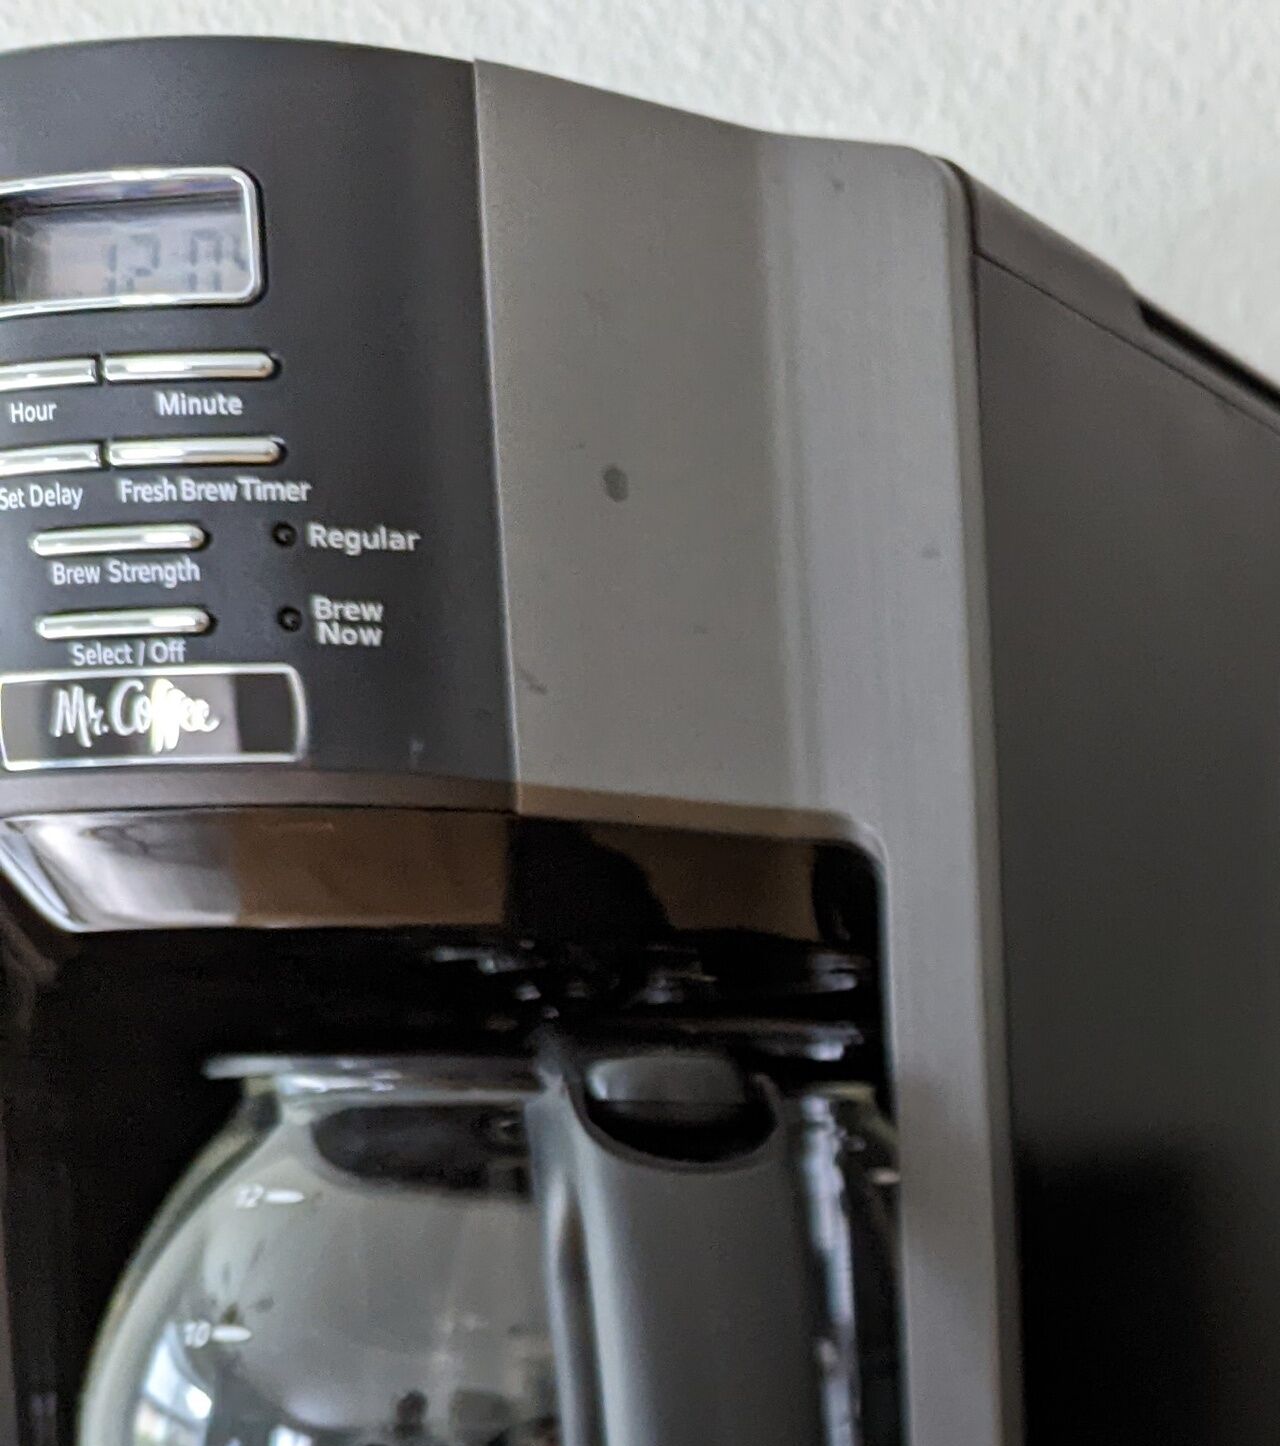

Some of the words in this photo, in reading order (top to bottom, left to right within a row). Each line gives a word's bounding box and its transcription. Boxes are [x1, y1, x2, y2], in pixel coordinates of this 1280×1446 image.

[10, 402, 58, 423] Hour
[157, 391, 244, 416] Minute
[0, 486, 26, 511] Set
[29, 481, 84, 511] Delay
[118, 475, 179, 503] Fresh
[181, 474, 238, 503] Brew
[236, 474, 311, 502] Timer
[307, 521, 421, 556] Regular
[52, 560, 100, 586] Brew
[106, 555, 201, 588] Strength
[311, 595, 384, 621] Brew
[316, 622, 383, 647] Now
[71, 641, 134, 667] Select
[149, 640, 187, 664] Off
[52, 684, 108, 748] Mr.
[110, 678, 221, 753] Coffee
